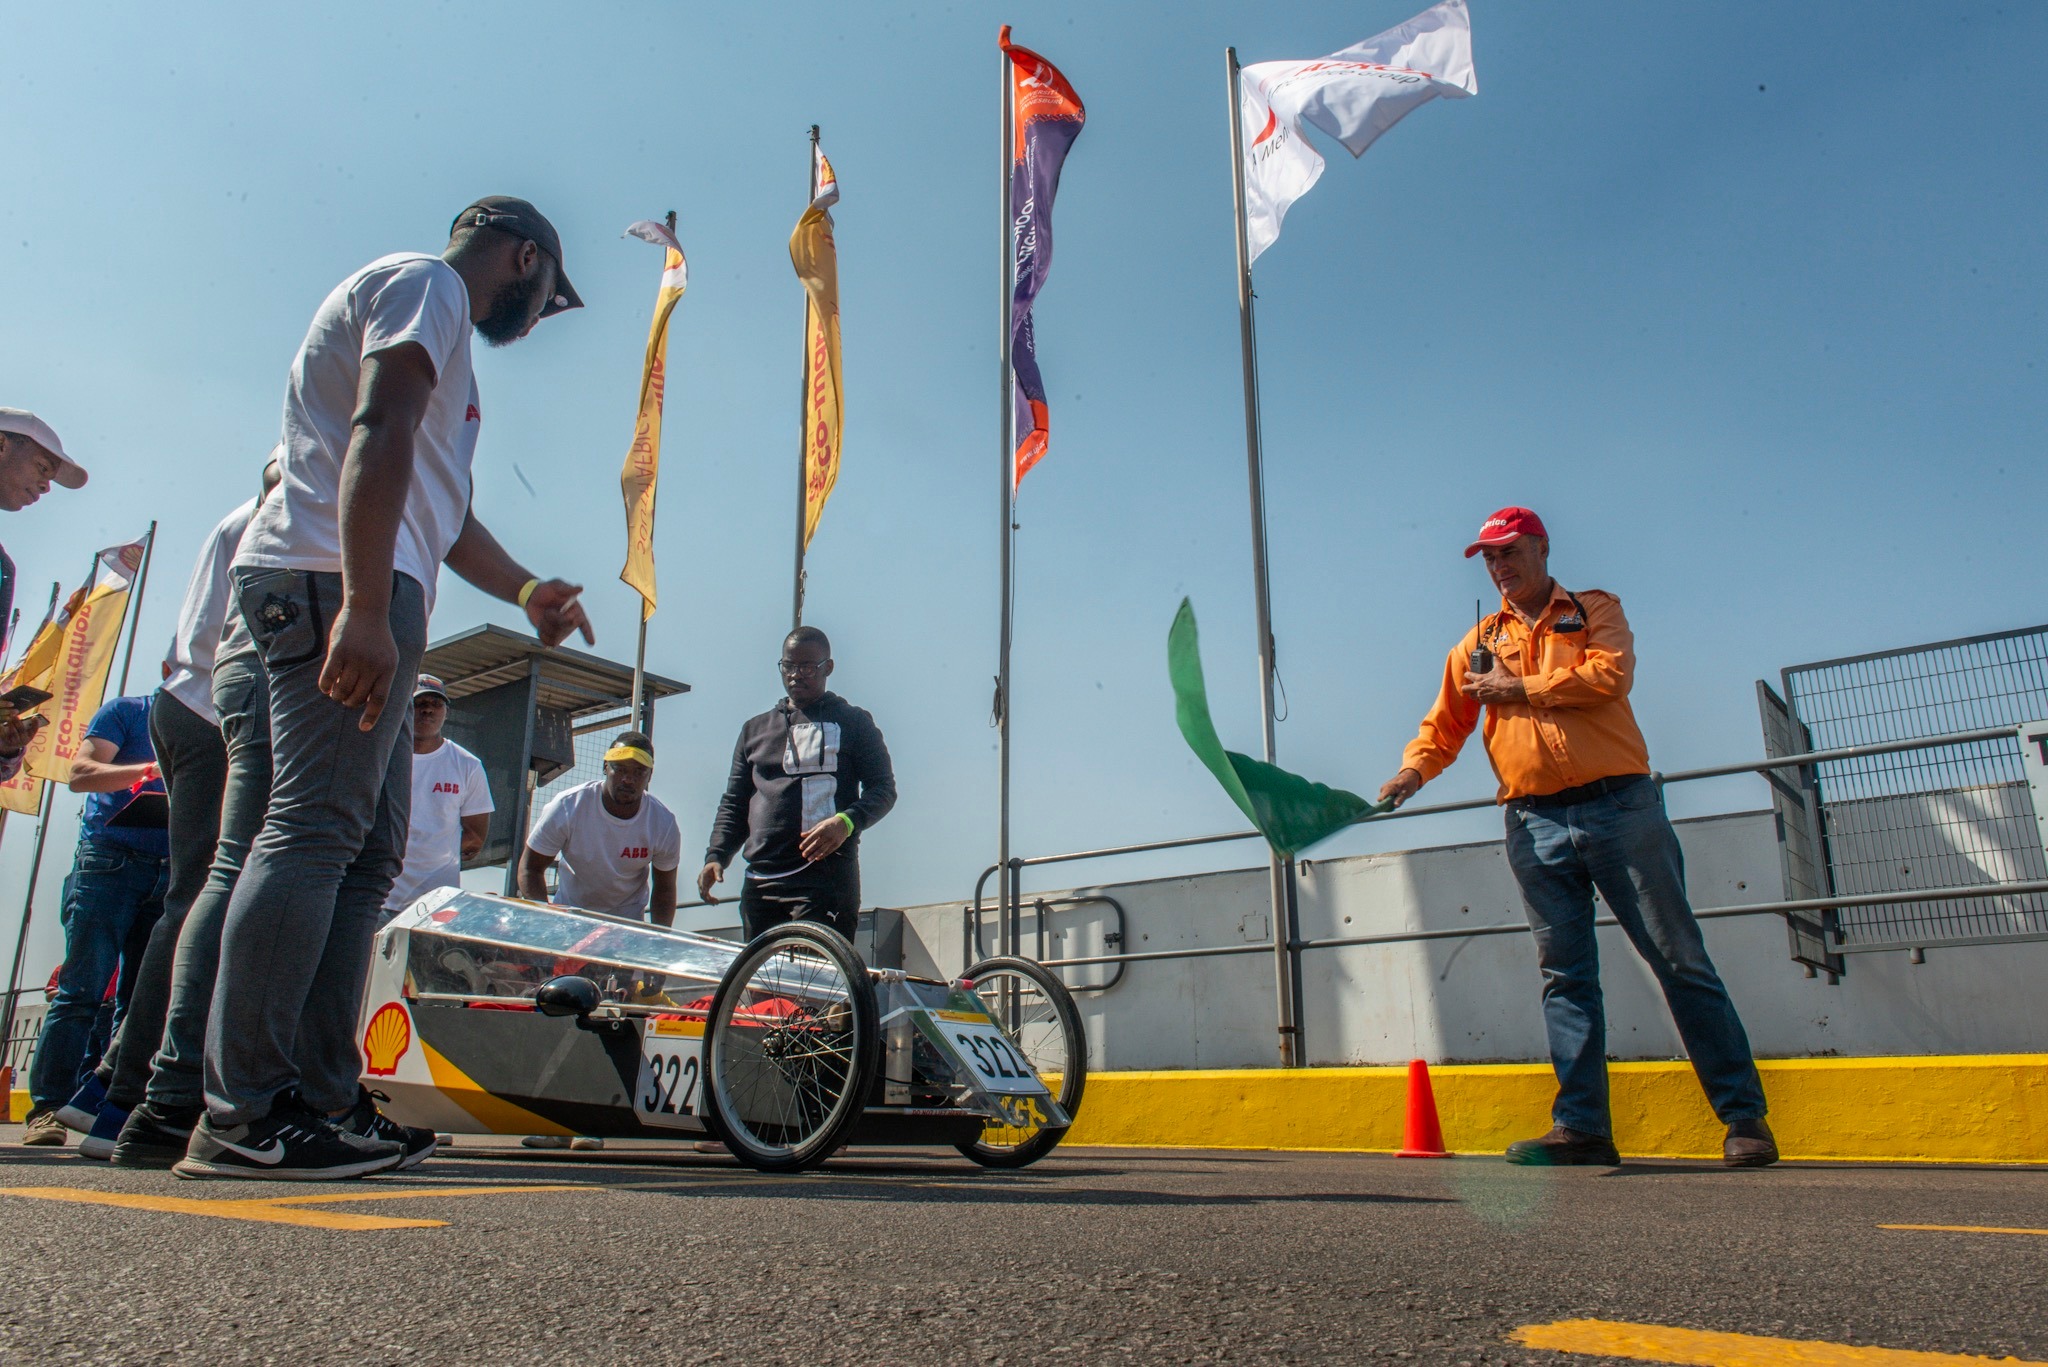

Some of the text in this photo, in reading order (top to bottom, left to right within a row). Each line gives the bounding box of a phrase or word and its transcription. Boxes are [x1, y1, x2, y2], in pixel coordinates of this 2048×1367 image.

[432, 782, 460, 794] ABB
[620, 847, 648, 859] ABB
[956, 1033, 1032, 1078] 322
[645, 1053, 699, 1116] 322
